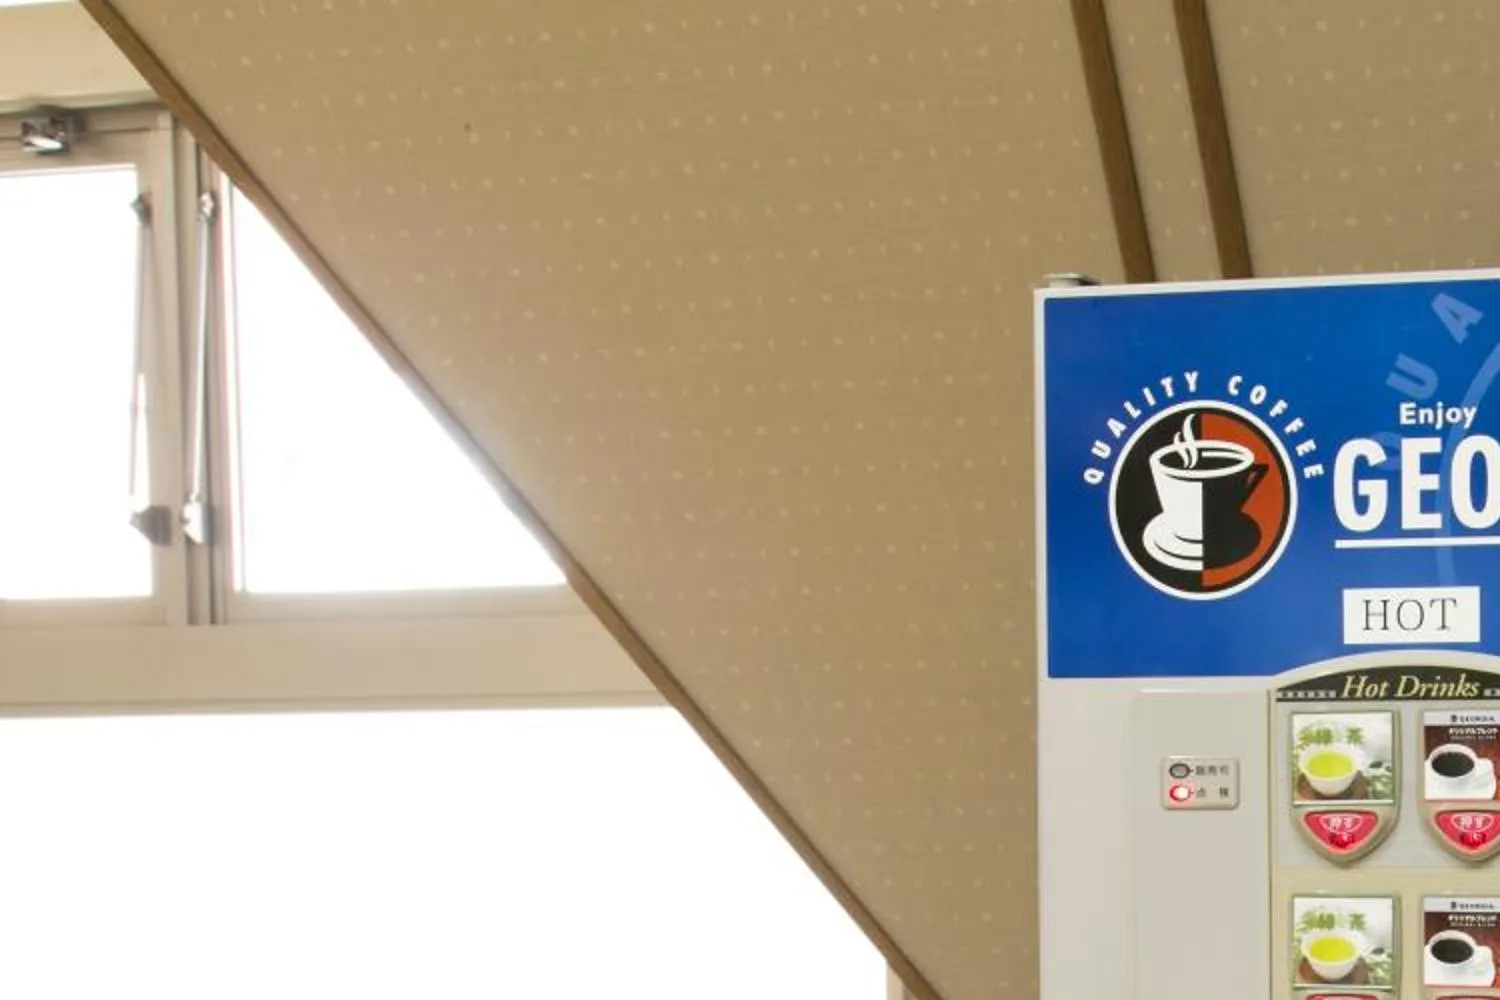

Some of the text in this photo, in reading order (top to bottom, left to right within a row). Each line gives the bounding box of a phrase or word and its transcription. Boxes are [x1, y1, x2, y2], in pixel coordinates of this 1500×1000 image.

[1083, 371, 1325, 485] QUALITY COFFEE
[1399, 402, 1477, 430] Enjoy
[1361, 598, 1458, 633] HOT
[1341, 674, 1481, 698] Hot Drinks
